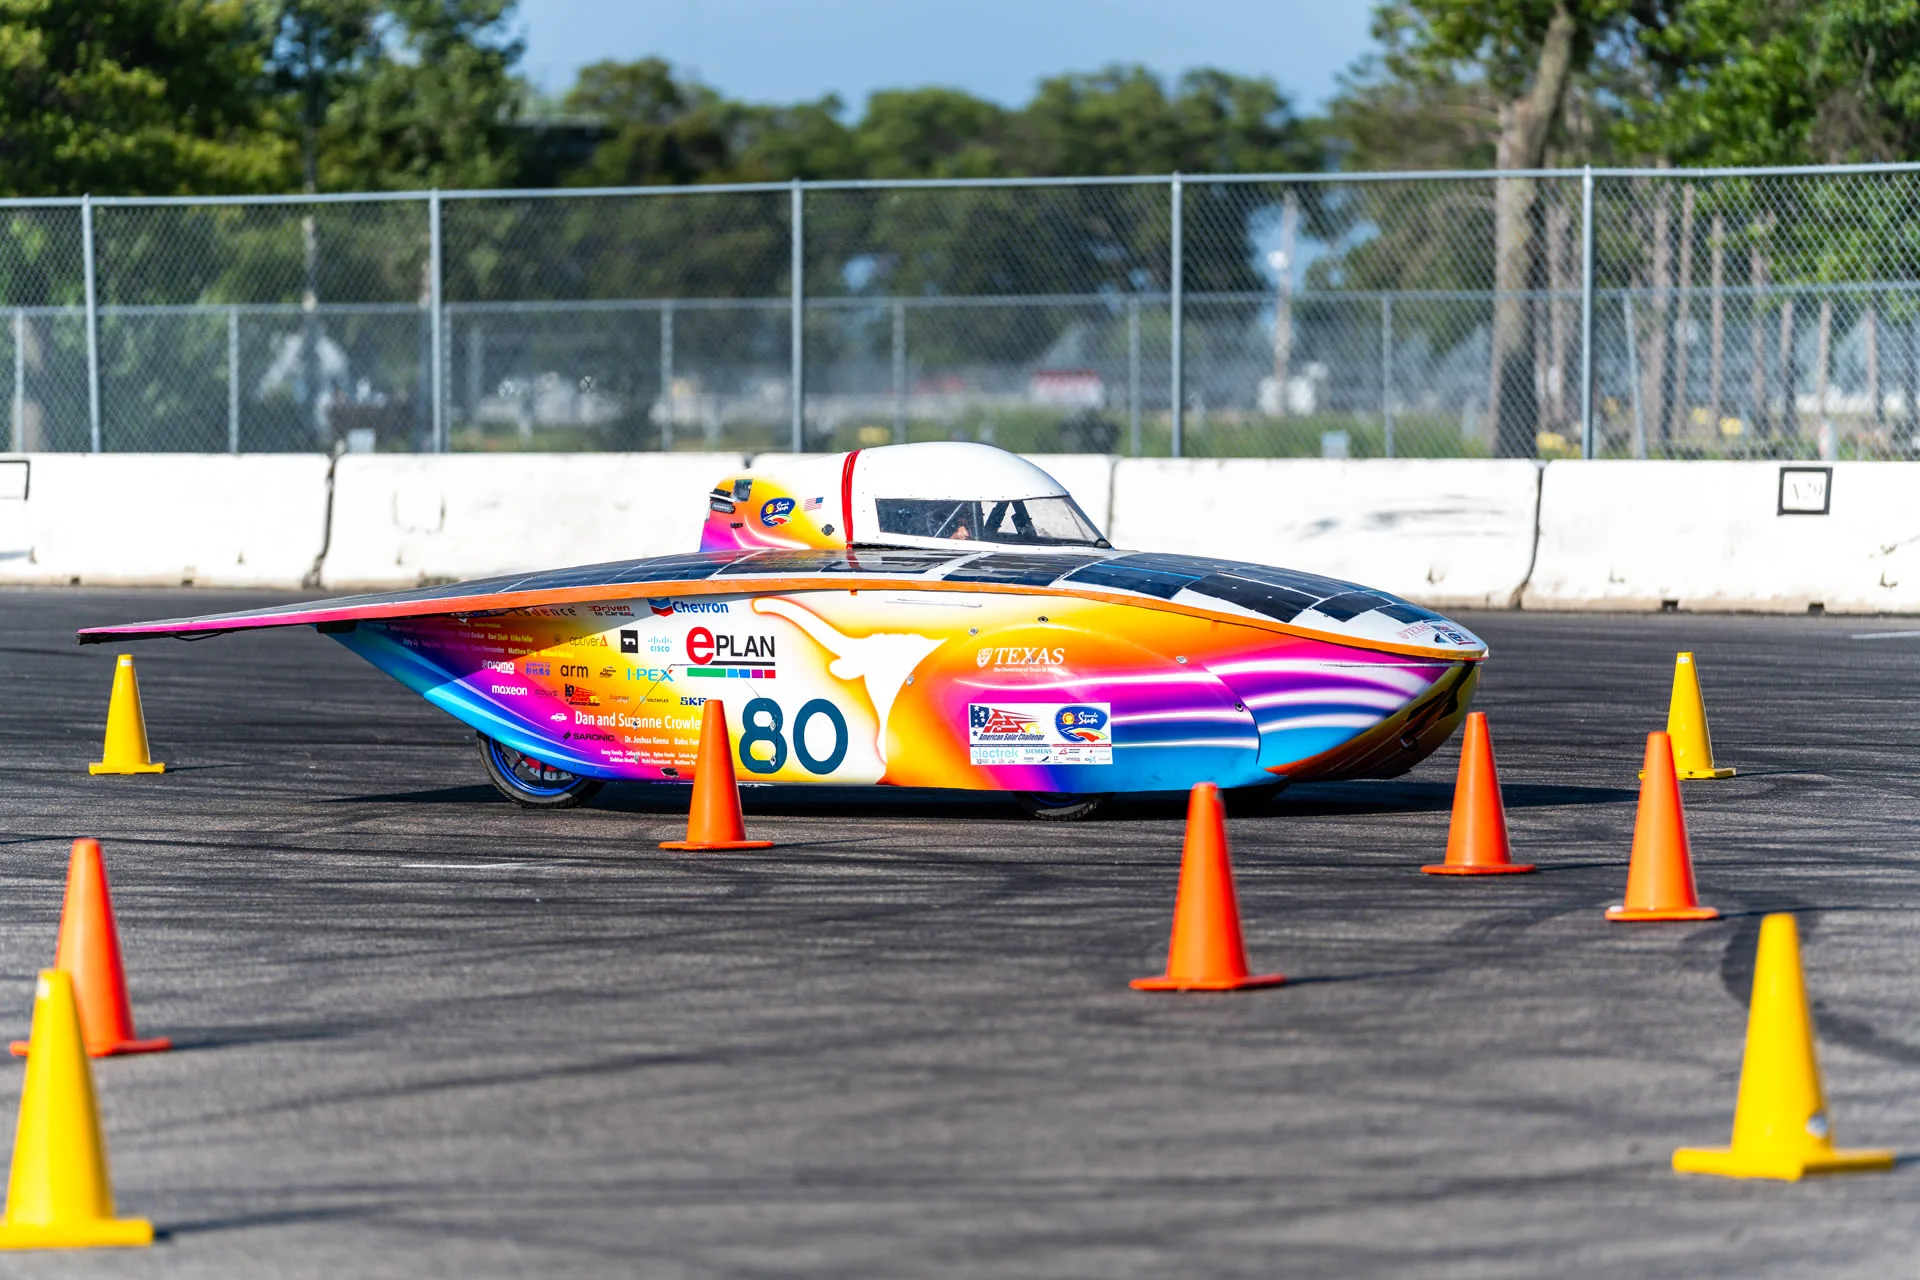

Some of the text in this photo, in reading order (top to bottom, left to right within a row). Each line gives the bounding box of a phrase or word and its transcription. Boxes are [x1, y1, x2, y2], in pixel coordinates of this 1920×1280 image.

[673, 601, 729, 614] Chevron
[569, 635, 600, 647] optiver
[994, 647, 1065, 665] TEXAS
[560, 664, 589, 678] arm
[627, 667, 674, 682] I-PEX
[491, 684, 528, 696] maxeon
[680, 696, 707, 706] SKF
[575, 711, 594, 725] Dan
[597, 712, 616, 727] and
[618, 713, 662, 728] Suzanne
[573, 732, 615, 742] SARONIC
[624, 735, 633, 743] Dr.
[633, 736, 652, 745] Joshua
[739, 697, 848, 775] 80
[978, 733, 1004, 741] American
[971, 747, 1020, 758] electrek
